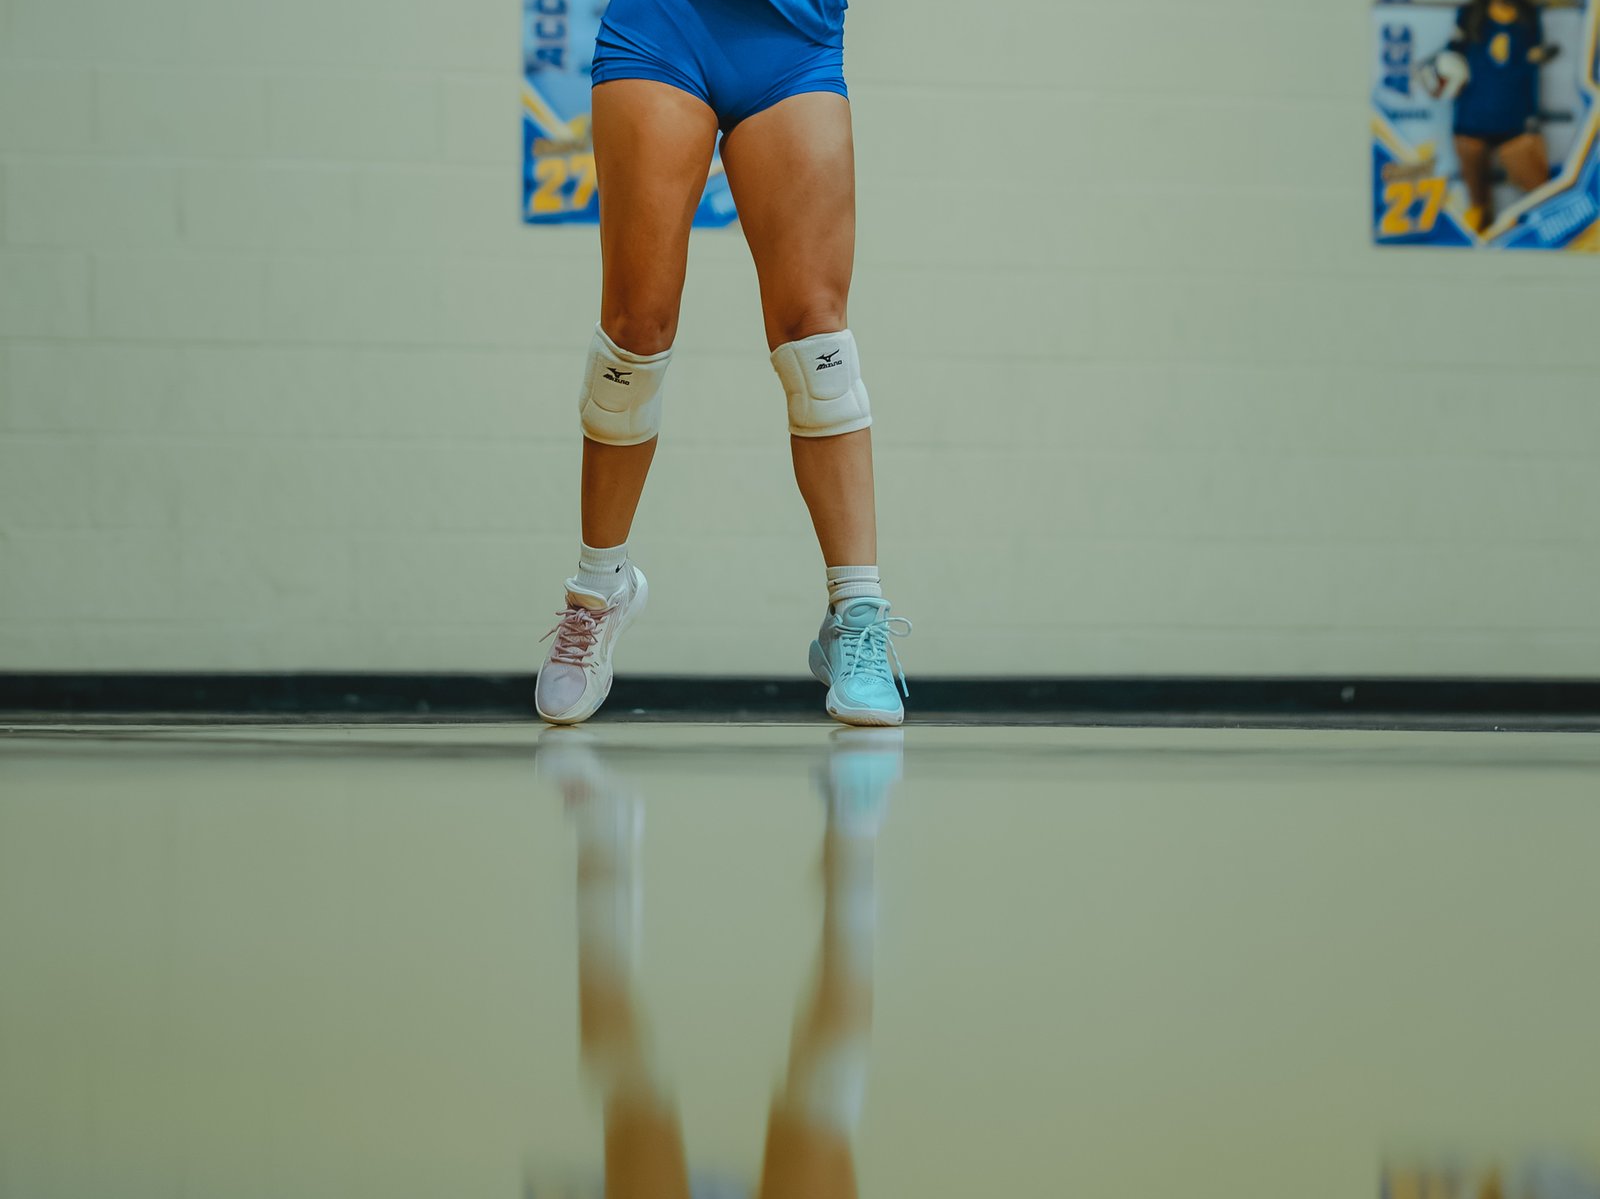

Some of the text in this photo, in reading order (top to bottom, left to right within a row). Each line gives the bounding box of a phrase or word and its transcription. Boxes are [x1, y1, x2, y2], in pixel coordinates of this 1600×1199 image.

[1381, 23, 1412, 97] ACC
[532, 153, 596, 212] 27
[1381, 176, 1447, 234] 27
